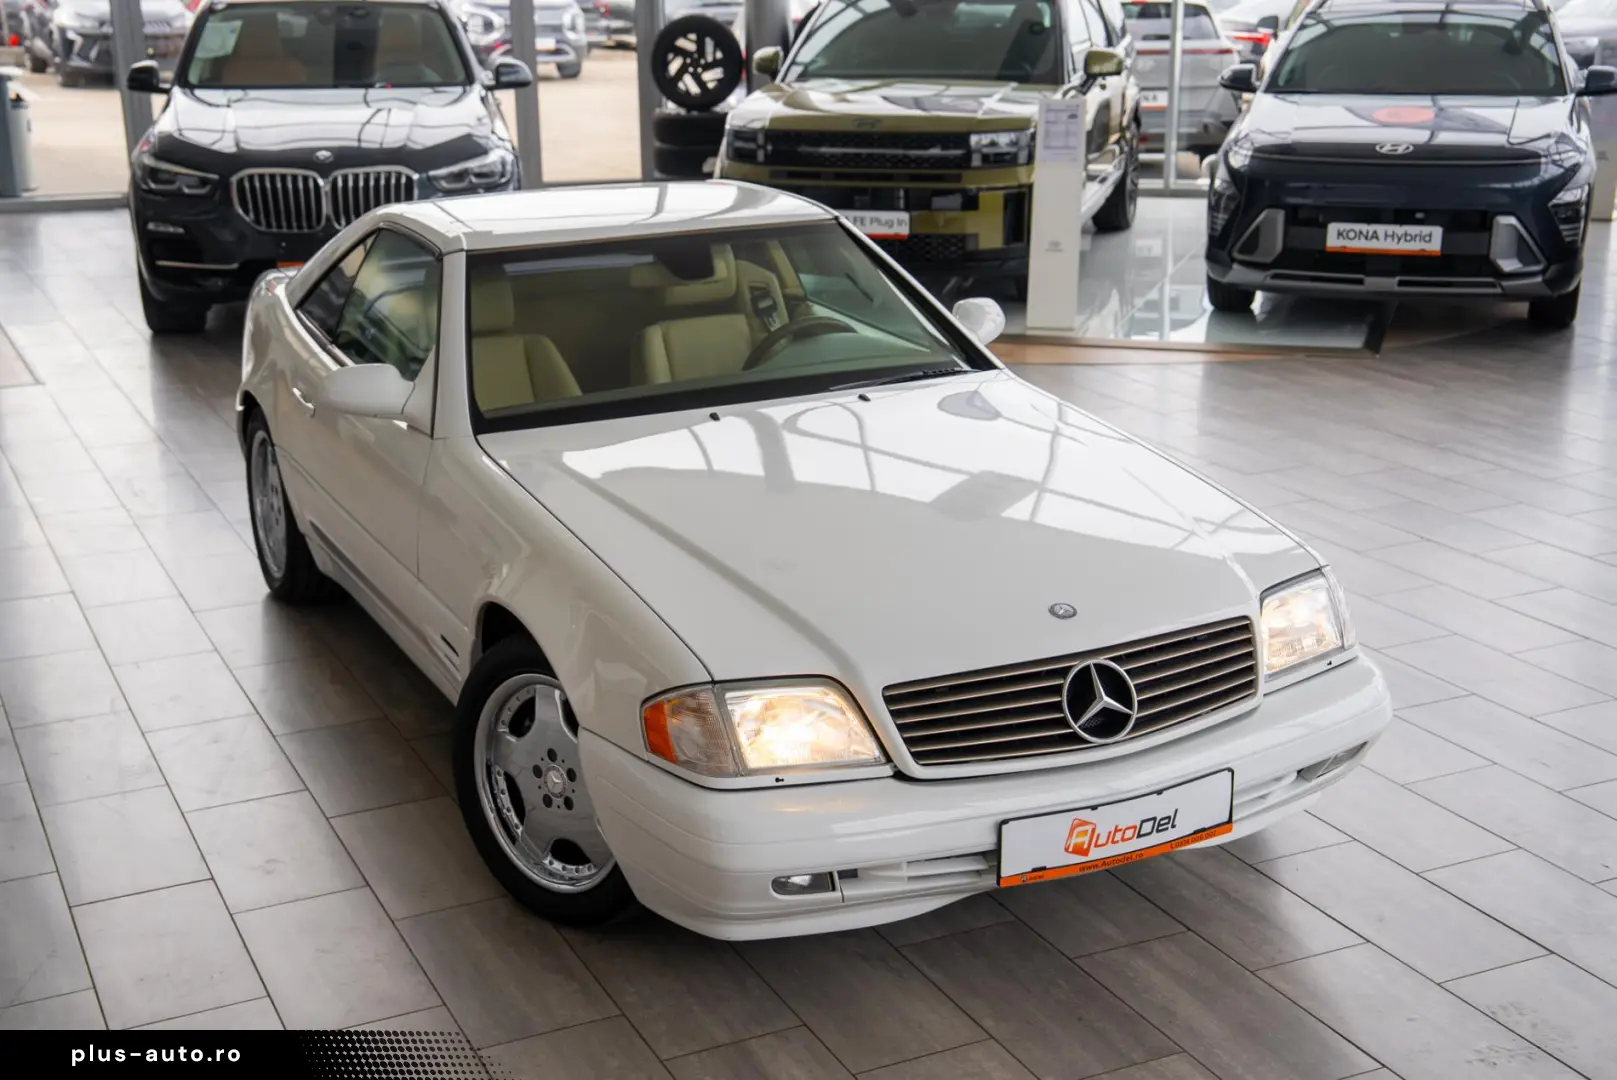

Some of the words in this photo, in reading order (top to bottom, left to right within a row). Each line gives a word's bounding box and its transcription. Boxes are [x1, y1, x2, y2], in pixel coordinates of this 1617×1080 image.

[870, 216, 895, 230] Plug
[897, 217, 908, 228] In
[1336, 228, 1380, 242] KONA
[1384, 229, 1433, 245] Hybrid
[1064, 808, 1179, 857] AutoDel
